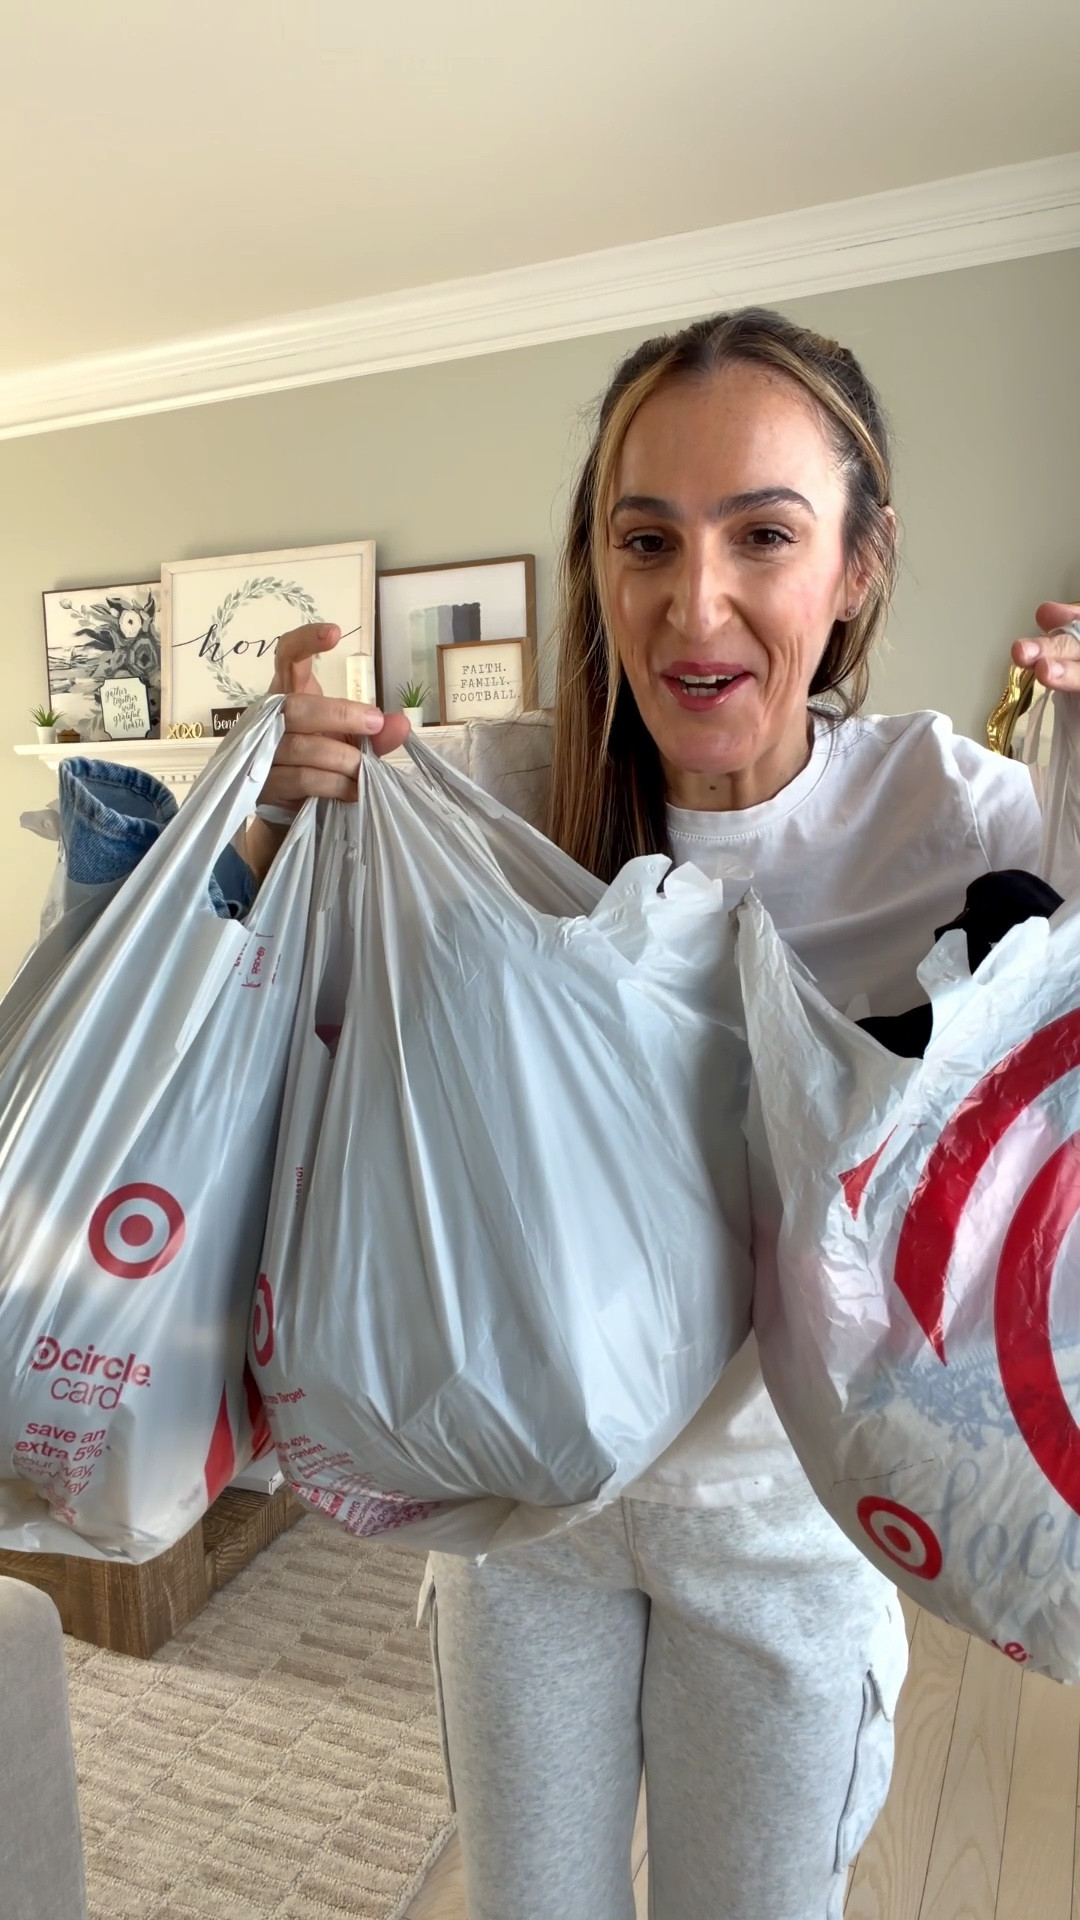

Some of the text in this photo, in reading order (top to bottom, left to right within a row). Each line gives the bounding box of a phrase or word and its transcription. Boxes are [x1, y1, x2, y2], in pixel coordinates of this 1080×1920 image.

[462, 662, 507, 675] FAITH.
[460, 676, 510, 689] FAMILY.
[105, 686, 128, 703] gather
[113, 694, 138, 708] together
[451, 689, 521, 703] FOOTBALL.
[121, 702, 136, 712] with
[113, 708, 141, 728] grateful
[122, 719, 145, 731] hearts
[51, 1377, 124, 1410] card
[25, 1422, 107, 1443] save an
[15, 1440, 103, 1462] extra 5%
